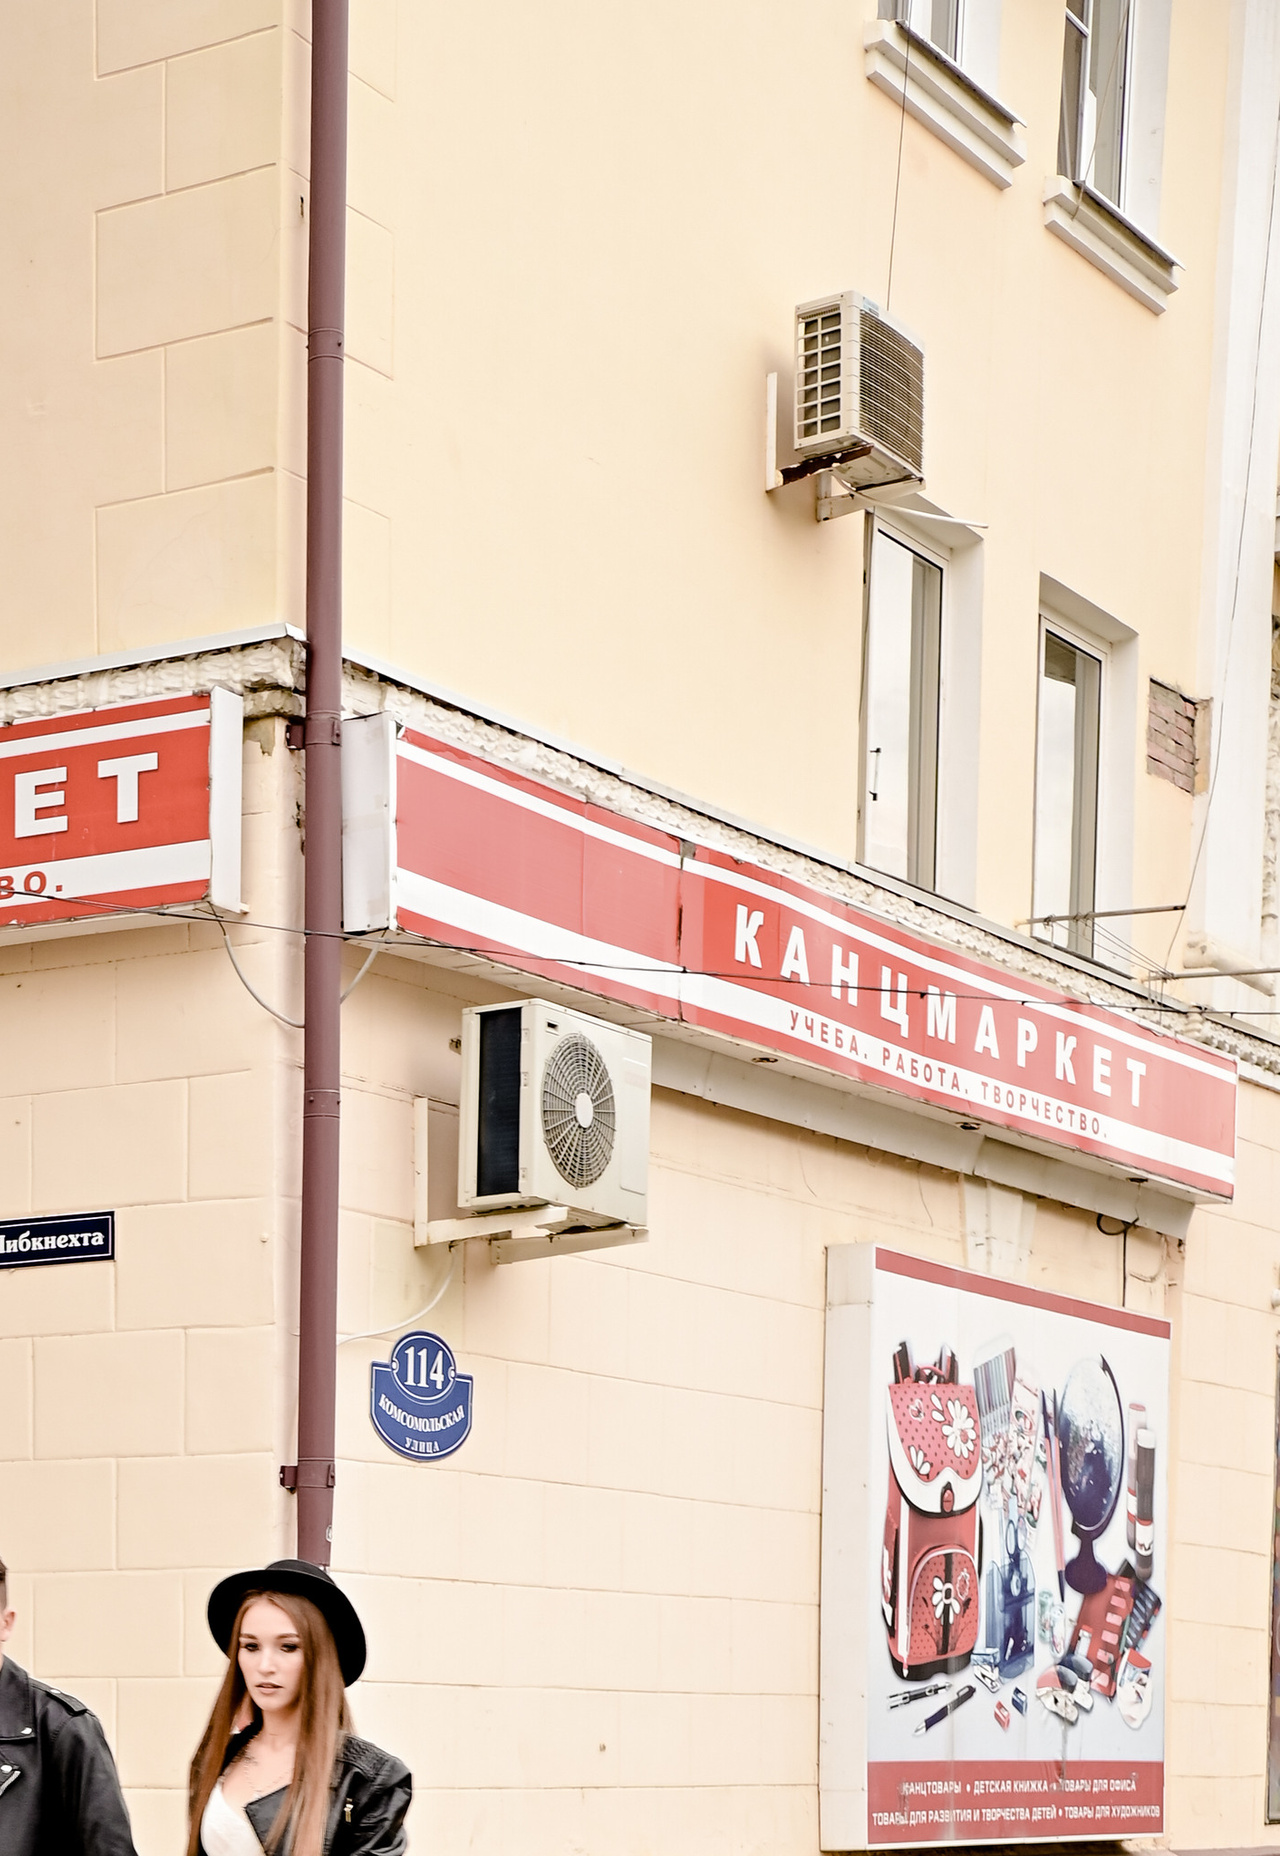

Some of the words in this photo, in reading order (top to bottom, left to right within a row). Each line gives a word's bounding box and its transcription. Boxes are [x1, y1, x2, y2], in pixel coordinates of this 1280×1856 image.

[734, 902, 1148, 1108] КАНЦМАРКЕТ
[790, 1009, 868, 1060] УЧЕБА.
[882, 1046, 969, 1095] РАБОТА.
[981, 1082, 1108, 1139] ТВОРЧЕСТВО.
[404, 1345, 444, 1390] 114
[378, 1394, 465, 1432] КОМСОМОЛЬСКАЯ
[405, 1437, 440, 1454] УЛИЦА
[974, 1780, 1012, 1796] ДЕТСКАЯ
[1013, 1780, 1049, 1792] КНИЖКА
[1092, 1779, 1109, 1794] ДЛЯ
[1109, 1778, 1137, 1791] ОФИСА
[909, 1810, 927, 1827] ДЛЯ
[928, 1808, 972, 1823] РАЗВИТИЯ
[973, 1808, 980, 1821] И
[981, 1807, 1031, 1821] ТВОРЧЕСТВА
[1031, 1804, 1057, 1822] ДЕТЕЙ
[1064, 1805, 1094, 1819] ТОВАРЫ
[1094, 1805, 1111, 1820] ДЛЯ
[1111, 1805, 1160, 1819] ХУДОЖНИКОВ
